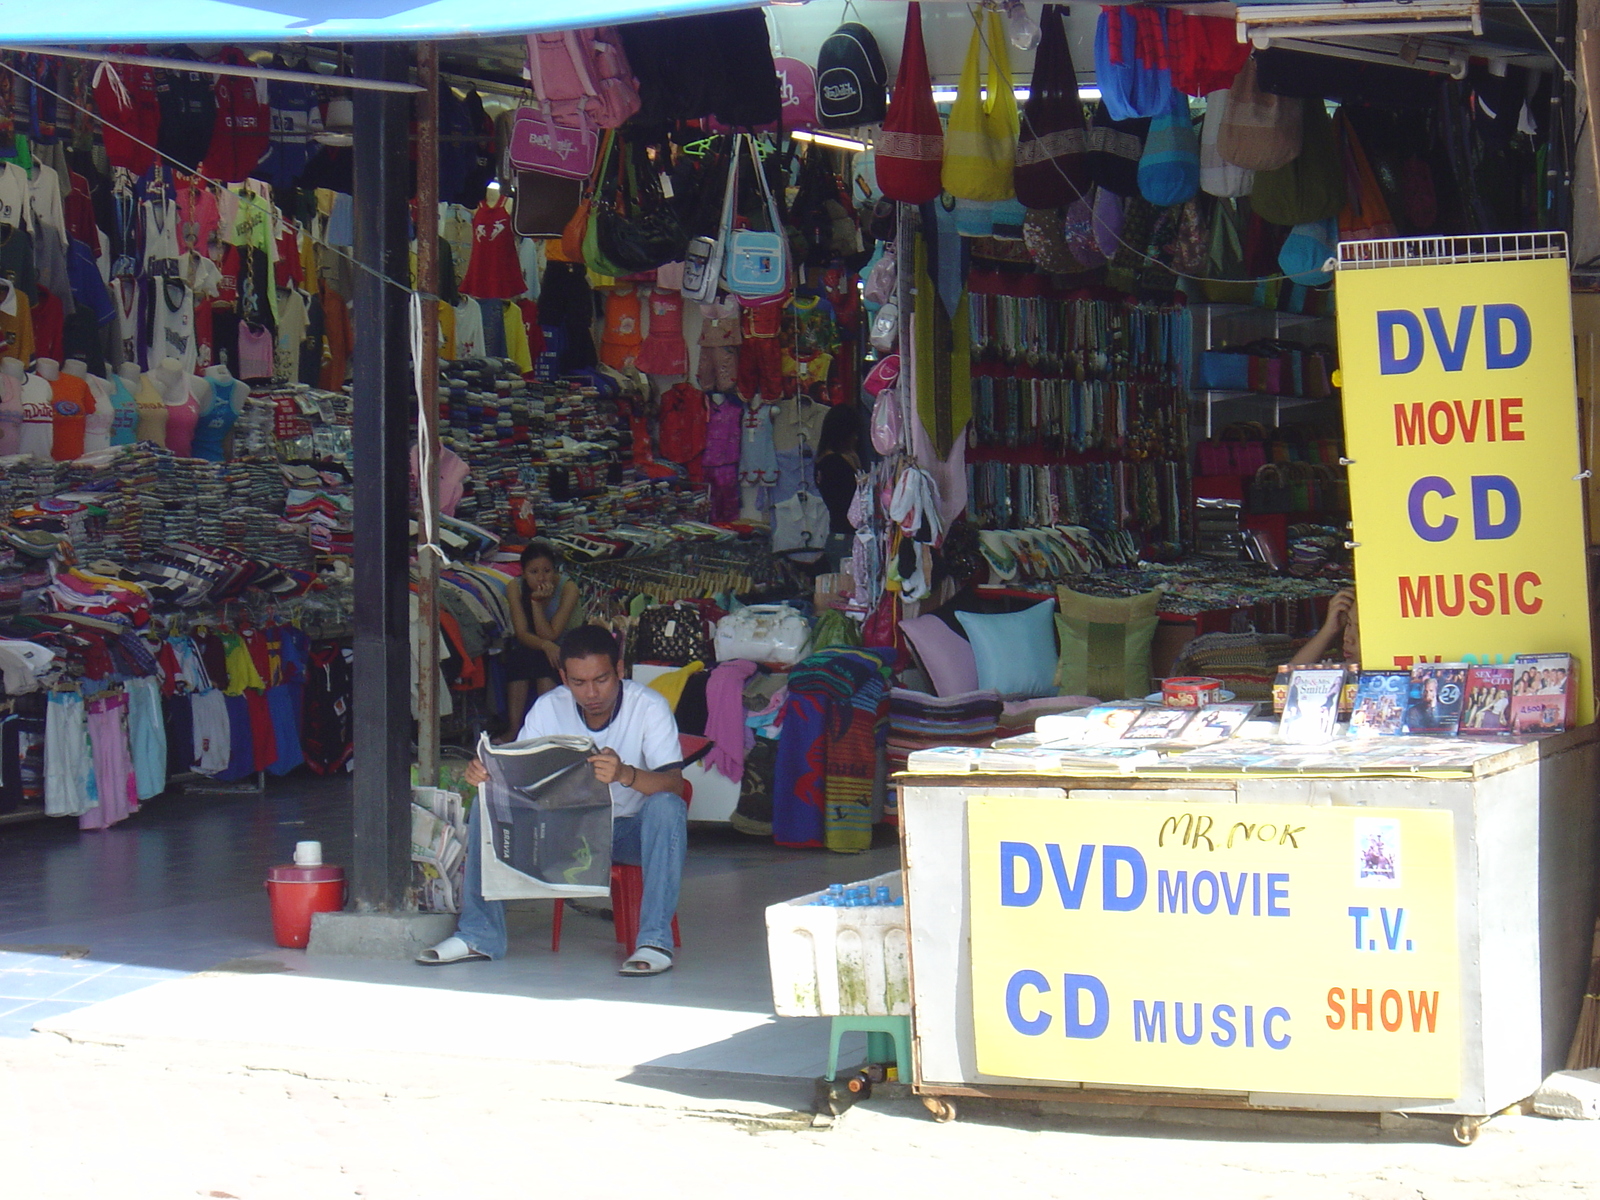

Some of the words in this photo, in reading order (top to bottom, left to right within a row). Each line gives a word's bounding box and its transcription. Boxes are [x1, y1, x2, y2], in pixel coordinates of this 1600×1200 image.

[1377, 304, 1532, 375] DVD
[1394, 398, 1525, 446] MOVIE
[1408, 475, 1521, 542] CD
[1399, 572, 1543, 617] MUSIC
[1300, 684, 1328, 694] Smith
[1441, 688, 1459, 701] 24
[1475, 670, 1491, 678] SEX
[1491, 677, 1513, 685] CITY
[502, 829, 511, 859] BRAVIA
[1227, 822, 1306, 850] NOK
[1000, 841, 1148, 912] DVD
[1158, 870, 1291, 917] MOVIE
[1349, 907, 1413, 950] T.V.
[1006, 970, 1110, 1040] CD
[1134, 1000, 1292, 1050] MUSIC
[1326, 987, 1439, 1033] SHOW
